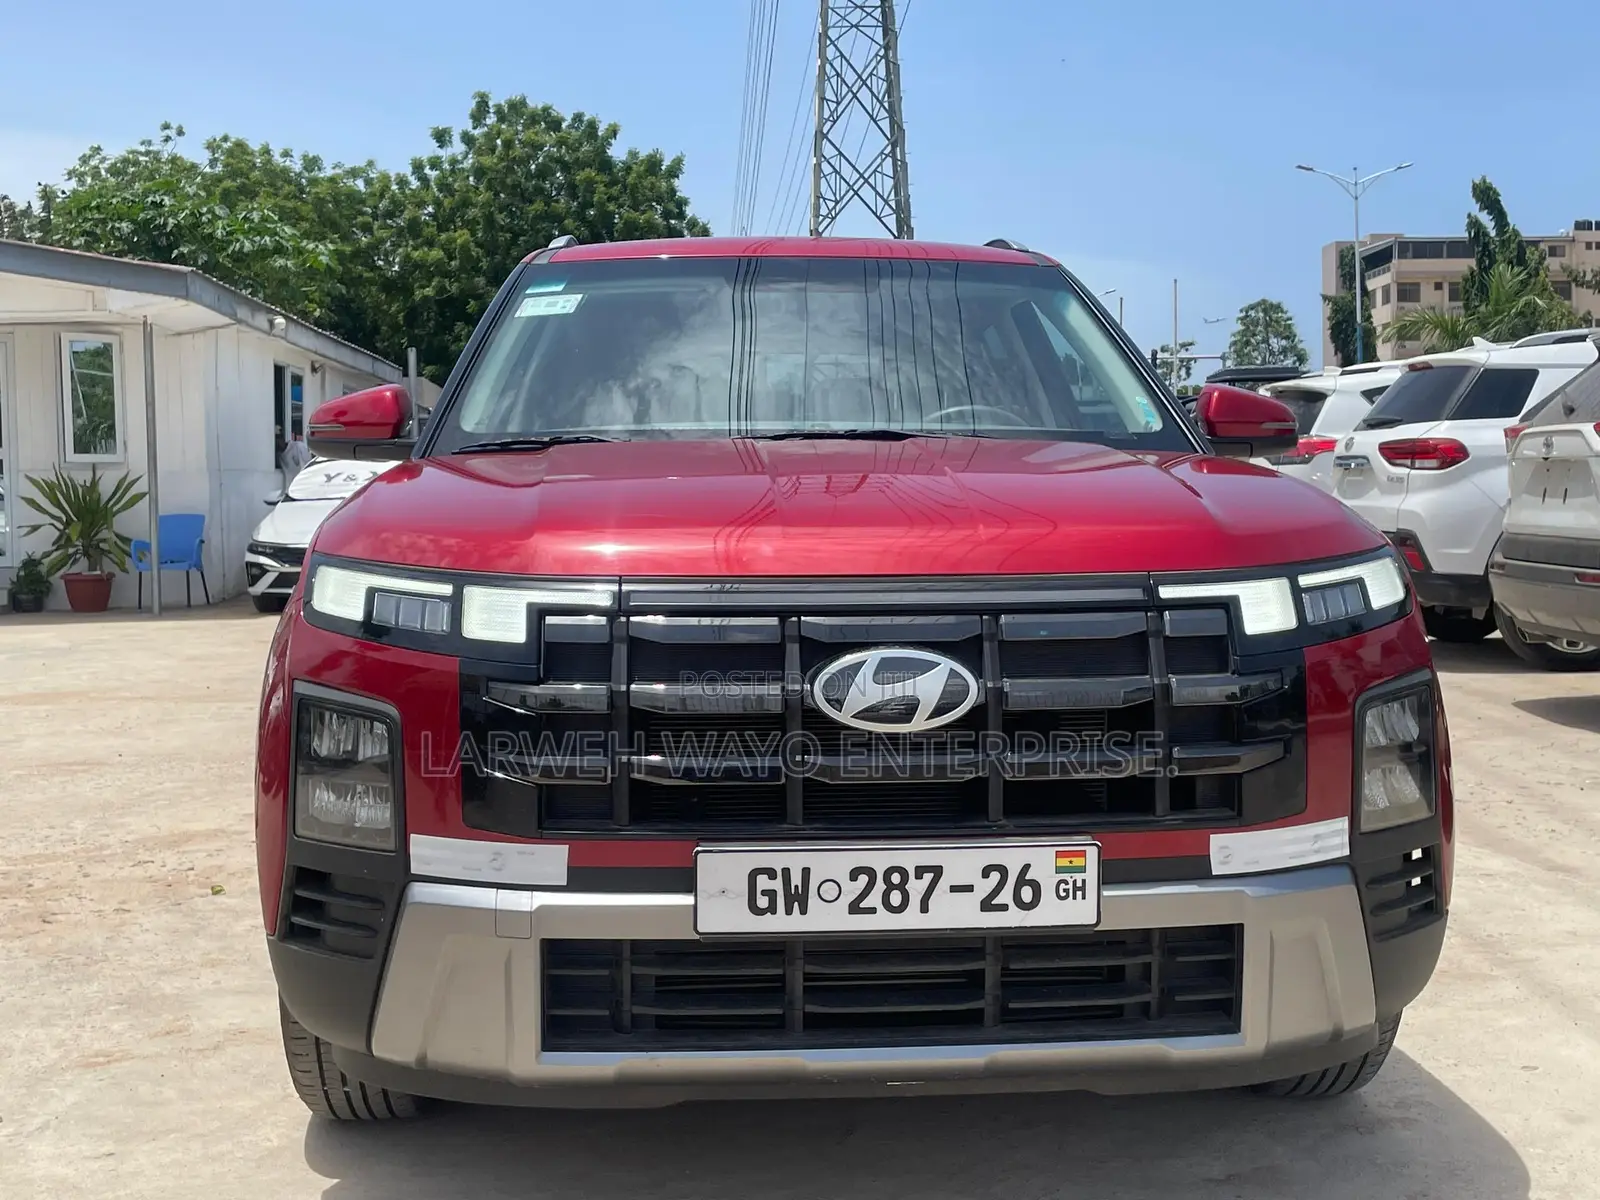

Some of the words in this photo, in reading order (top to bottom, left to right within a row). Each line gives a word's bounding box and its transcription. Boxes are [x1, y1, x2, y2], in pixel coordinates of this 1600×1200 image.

[747, 866, 812, 916] GW
[847, 863, 1043, 915] 287-26
[1054, 877, 1088, 902] GH
